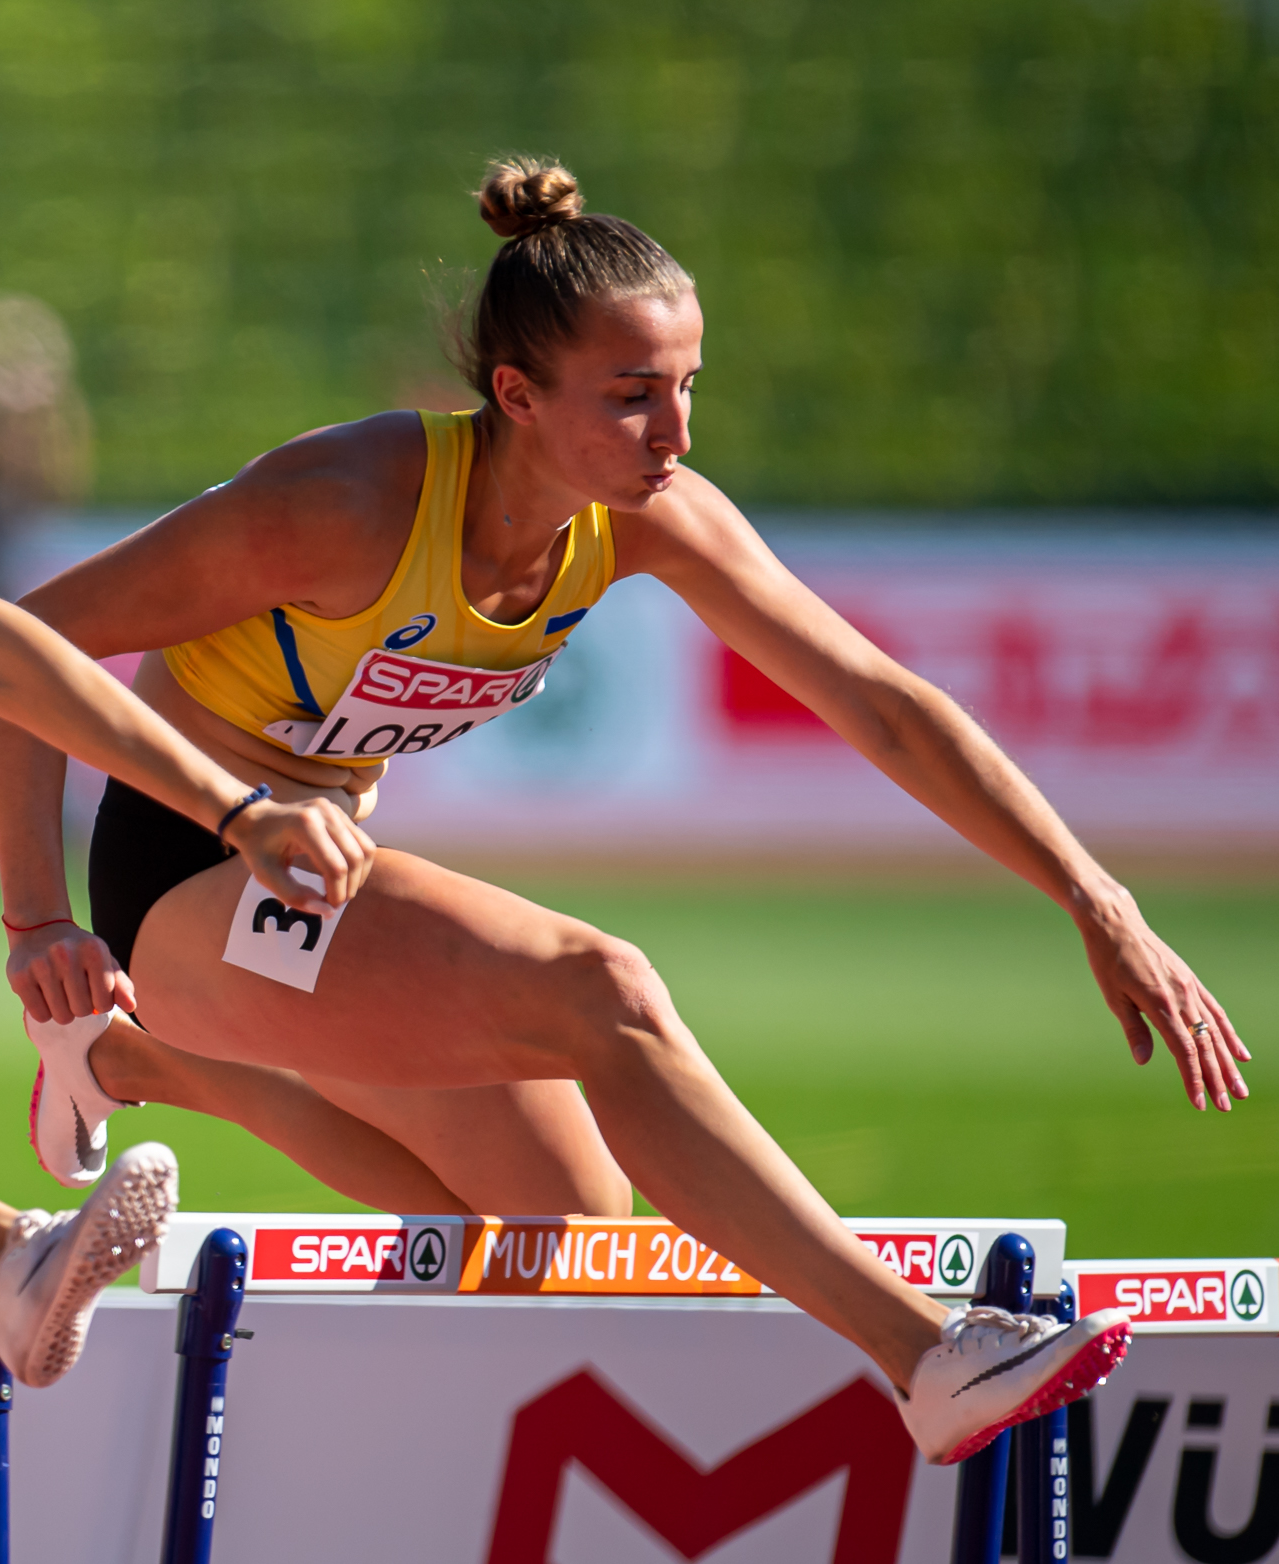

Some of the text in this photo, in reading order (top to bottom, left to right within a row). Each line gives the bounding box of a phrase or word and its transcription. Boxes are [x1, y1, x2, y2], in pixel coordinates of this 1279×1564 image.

[362, 662, 515, 704] SPAR
[314, 714, 499, 755] LOBA
[252, 897, 323, 952] 3
[289, 1235, 404, 1274] SPAR
[483, 1230, 635, 1281] MUNICH
[861, 1239, 934, 1279] AR
[1114, 1276, 1225, 1317] SPAR
[201, 1415, 224, 1520] MONDO
[1050, 1456, 1068, 1560] MONDO
